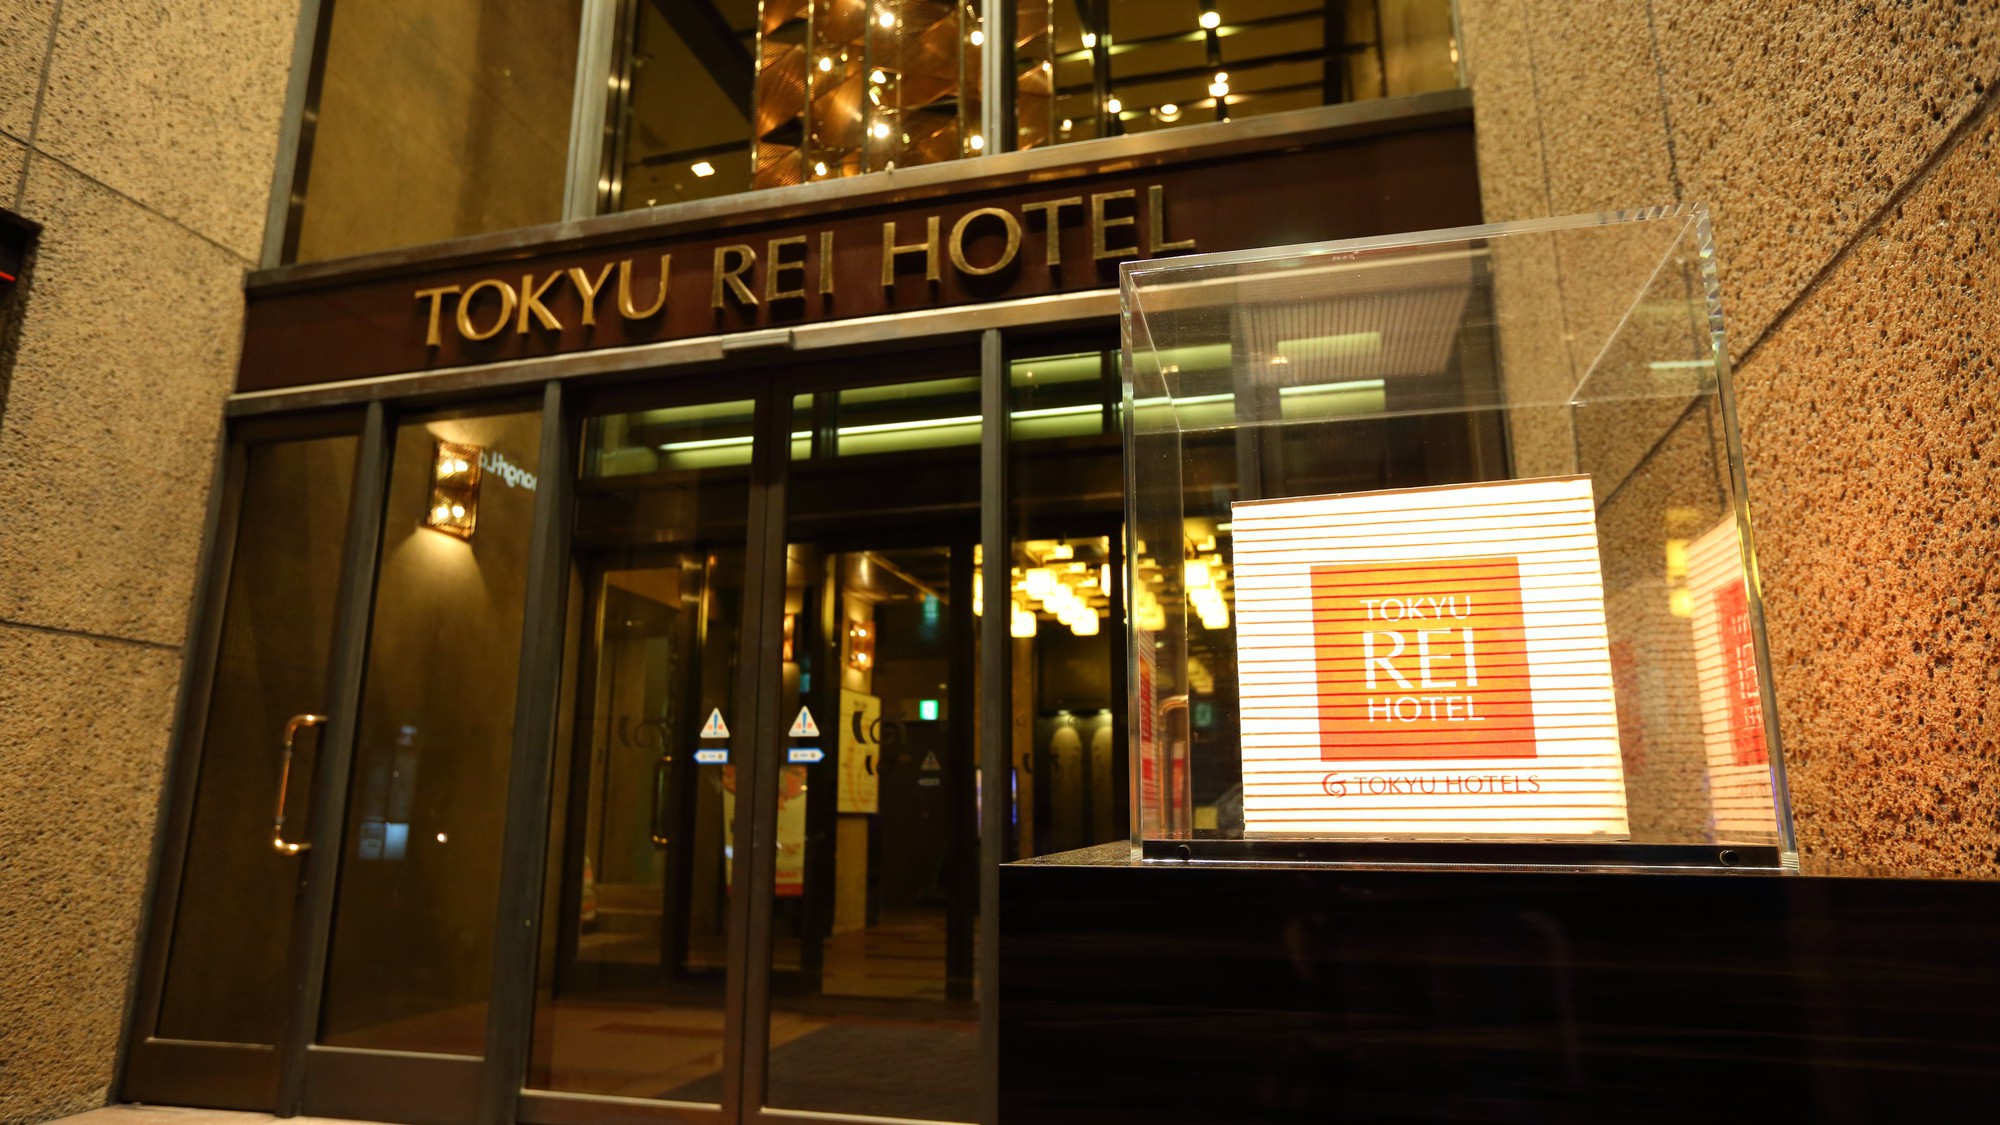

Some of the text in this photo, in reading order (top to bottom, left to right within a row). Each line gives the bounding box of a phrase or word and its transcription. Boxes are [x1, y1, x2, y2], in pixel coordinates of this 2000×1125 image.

[415, 185, 1195, 346] TOKYU REI HOTEL
[1360, 596, 1471, 622] TOKYU
[1362, 626, 1478, 690] REI
[1367, 695, 1485, 722] HOTEL
[1353, 775, 1540, 795] TOKYU HOTELS
